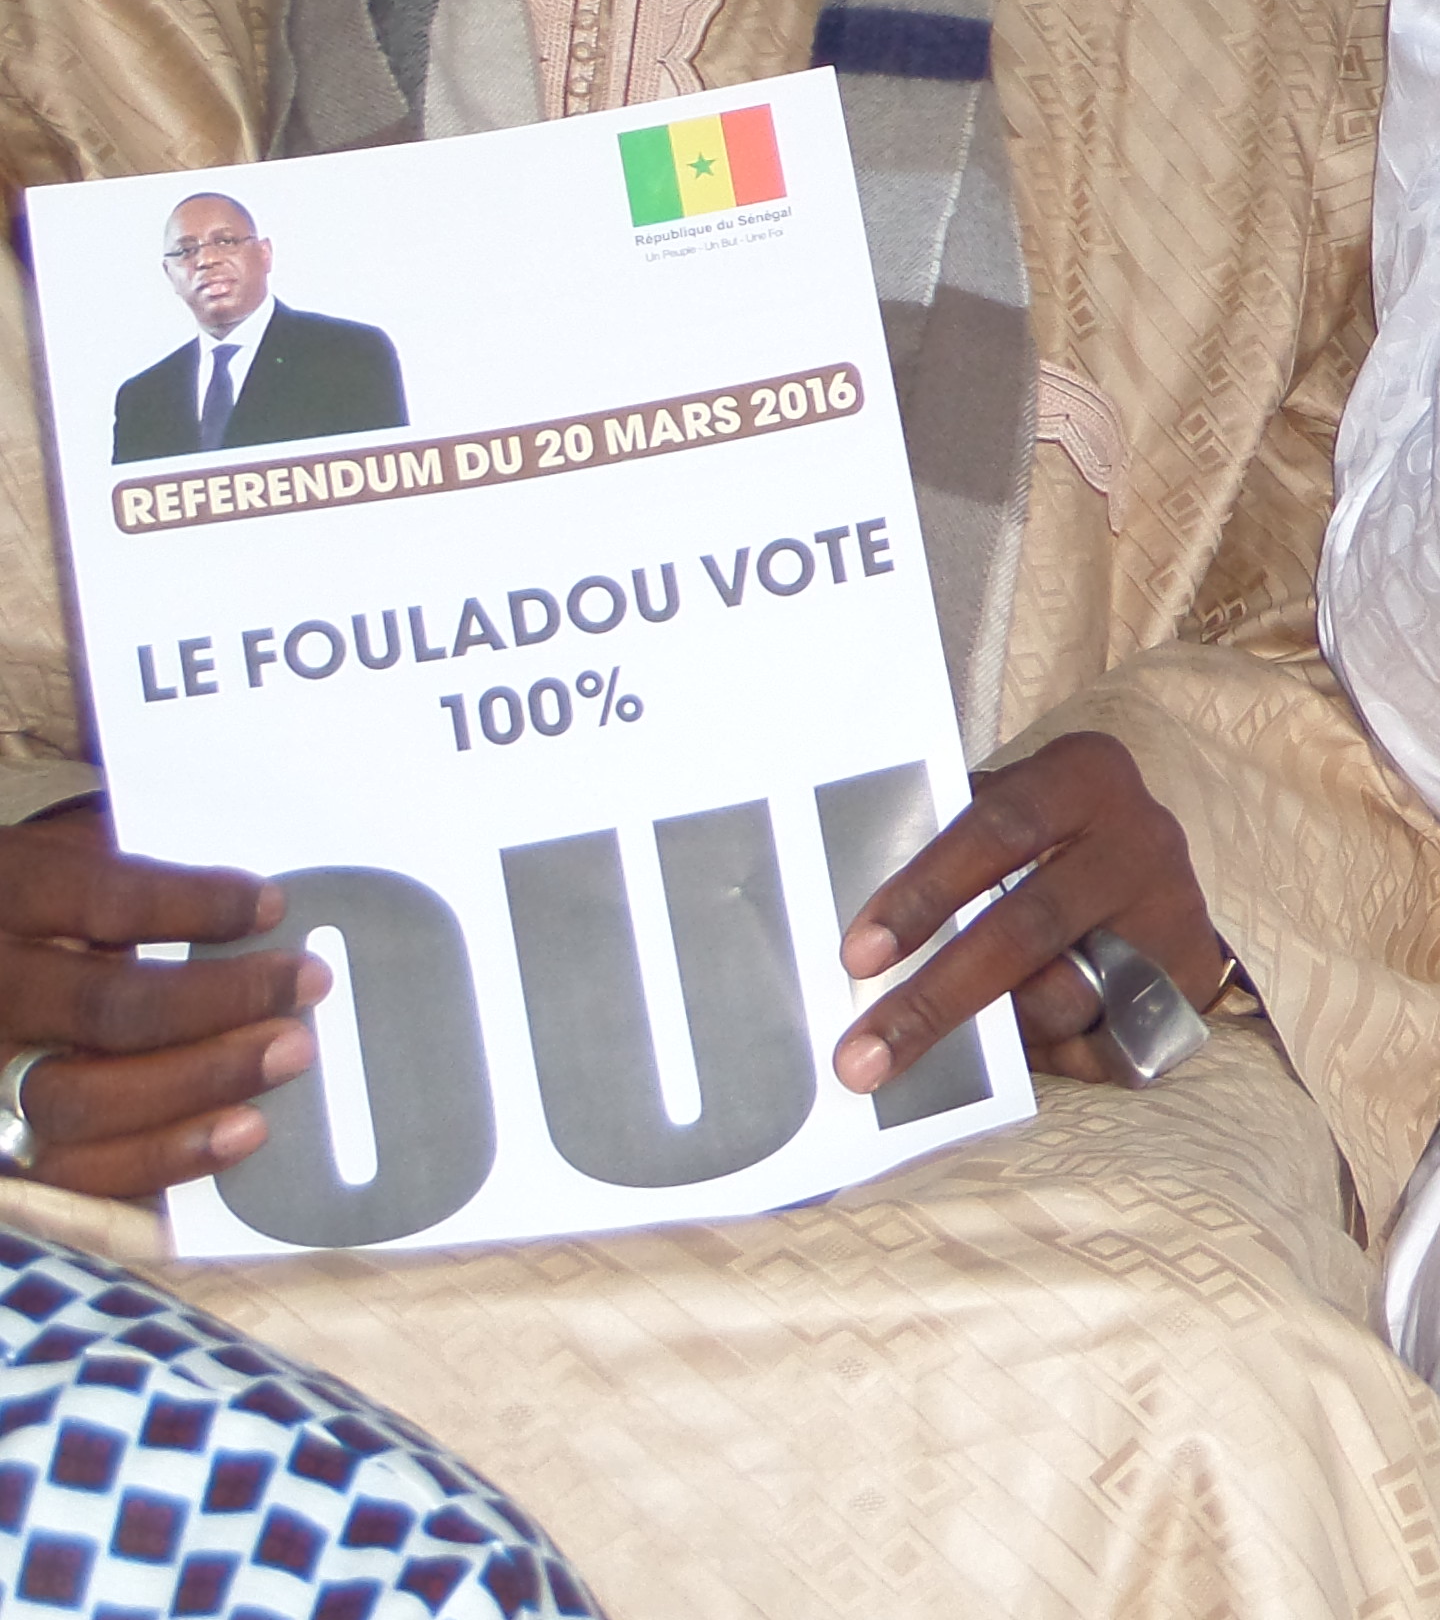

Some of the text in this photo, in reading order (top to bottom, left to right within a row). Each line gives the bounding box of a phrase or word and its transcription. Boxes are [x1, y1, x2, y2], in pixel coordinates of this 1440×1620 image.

[635, 206, 792, 246] République du Sénégal
[122, 372, 856, 526] REFERENDUM DU 20 MARS 2016
[138, 518, 893, 702] LE FOULADOU VOTE
[441, 667, 642, 751] 100%
[188, 759, 995, 1248] OUI
